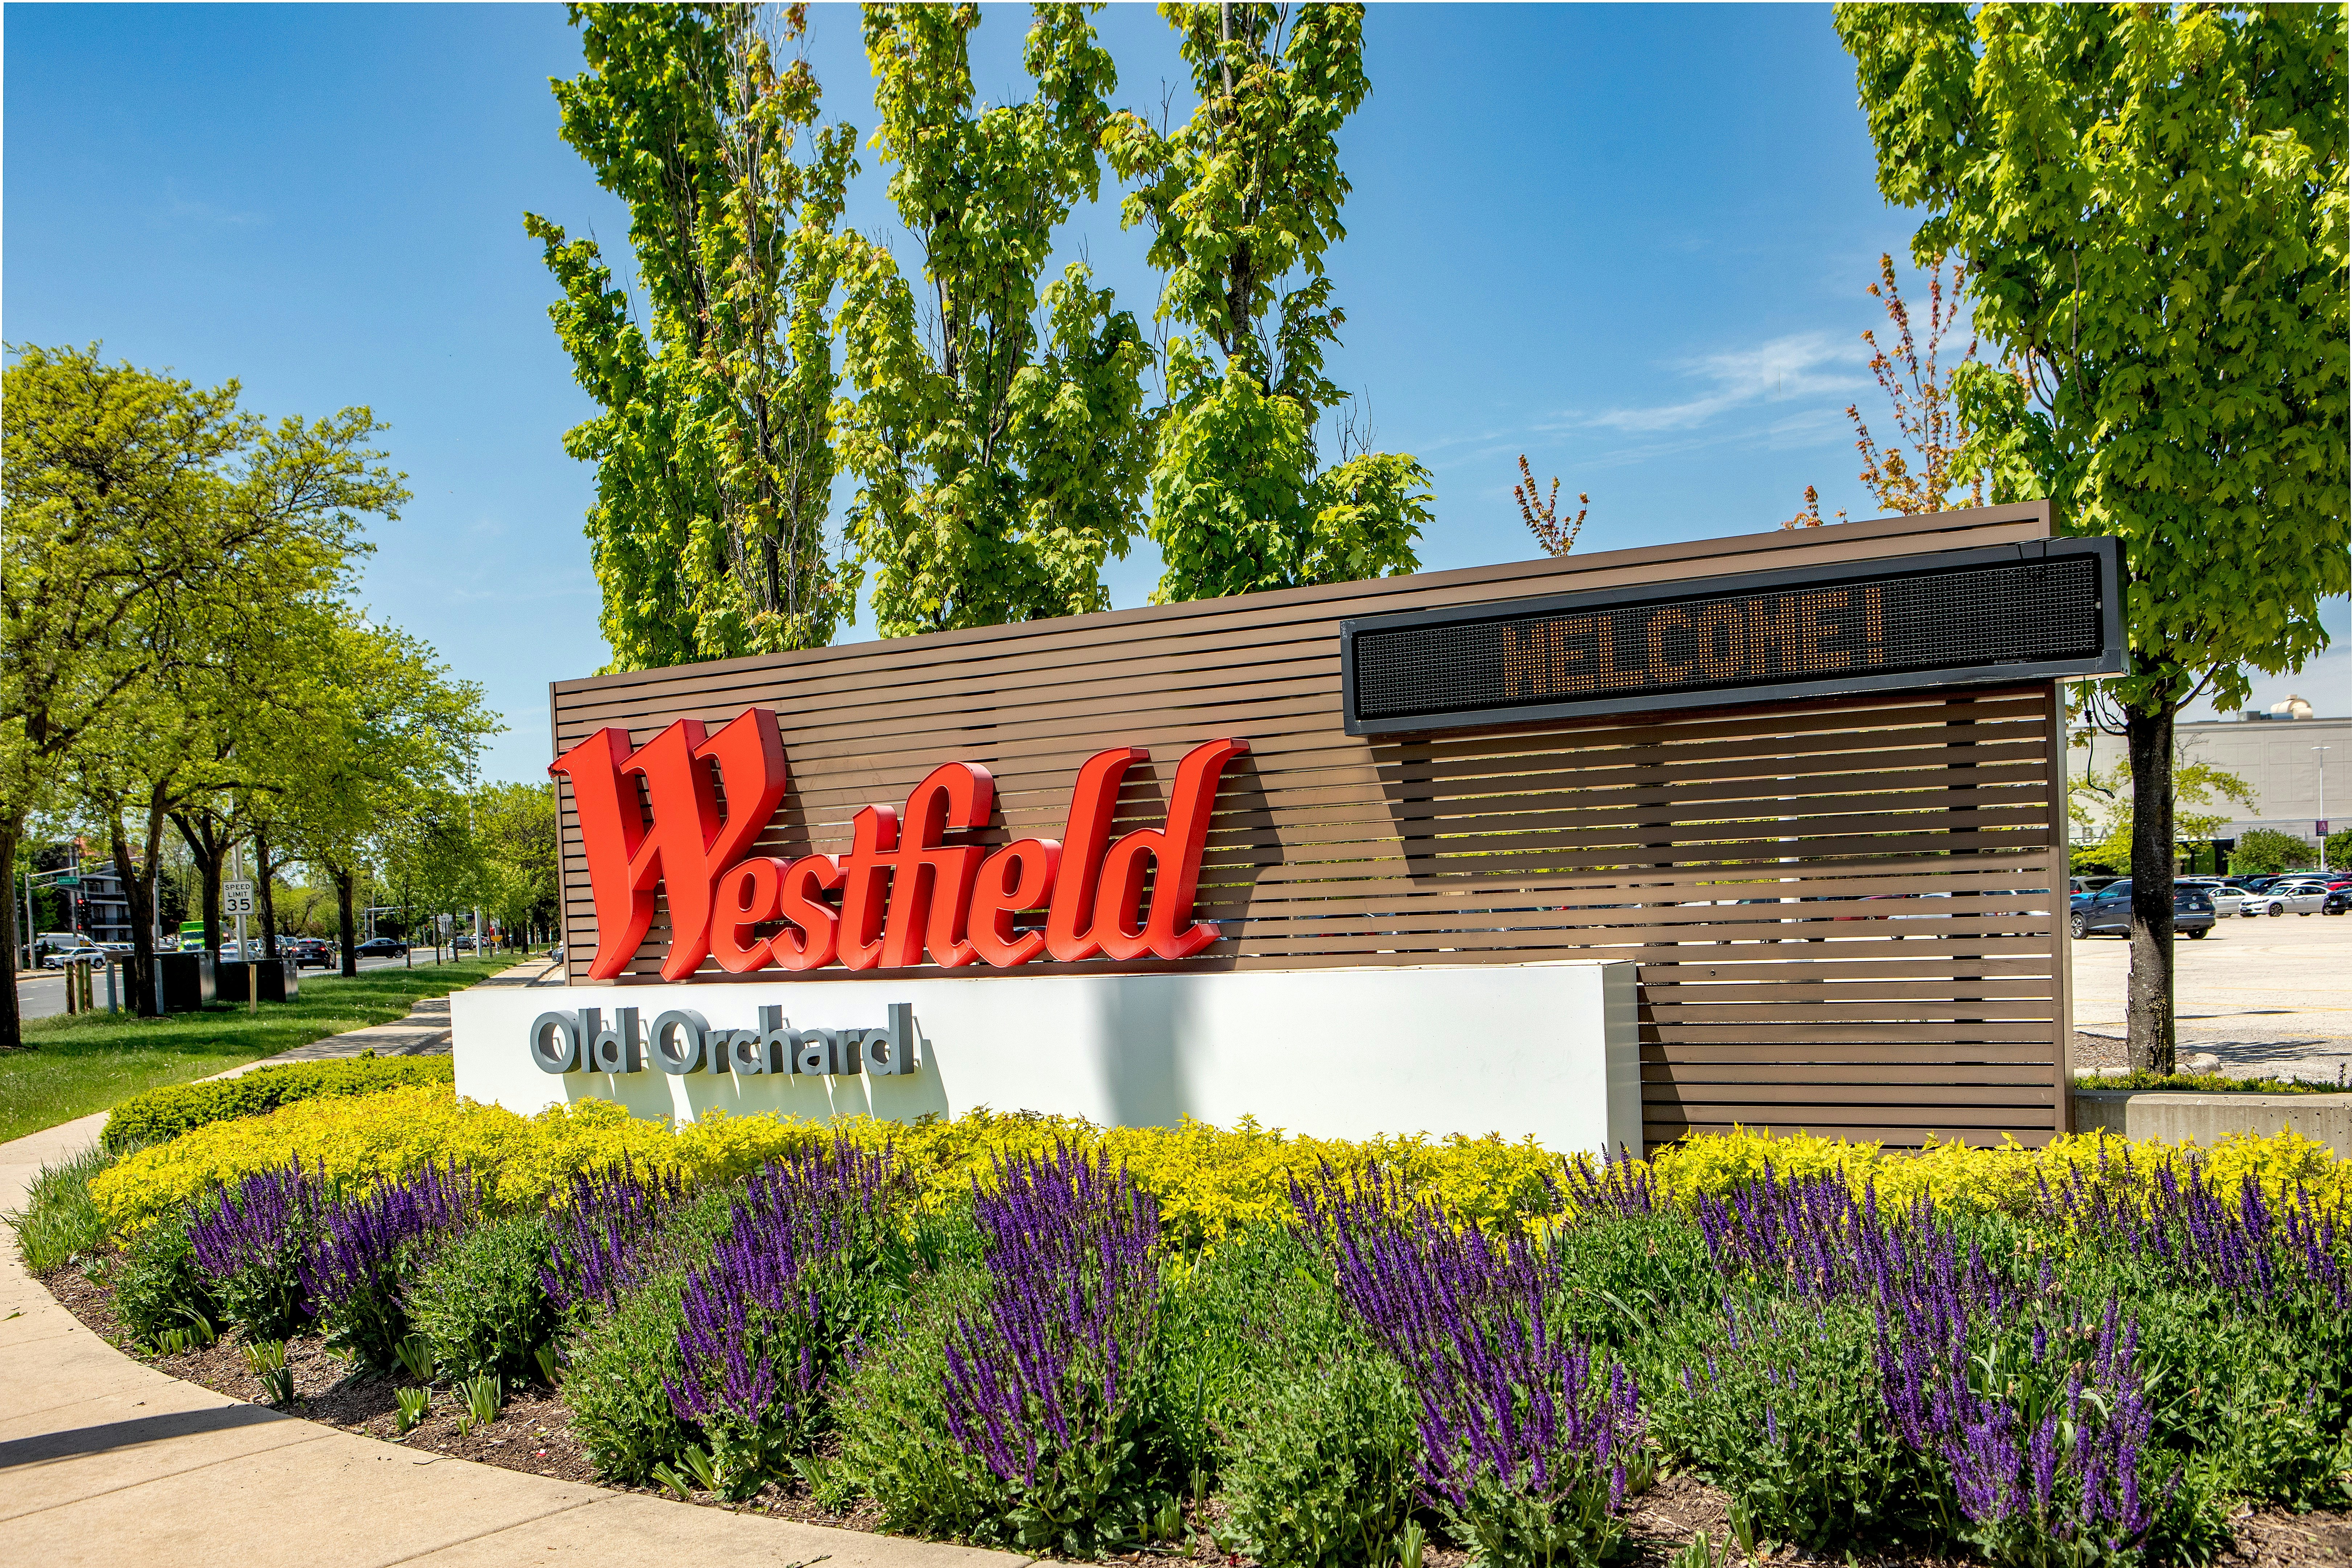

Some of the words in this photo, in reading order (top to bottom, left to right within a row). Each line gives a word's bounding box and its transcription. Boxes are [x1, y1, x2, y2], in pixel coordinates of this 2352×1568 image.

[1502, 587, 1883, 696] WELCOME!
[548, 707, 1250, 981] Westfield
[2319, 822, 2327, 830] A
[227, 898, 250, 911] 35
[530, 1006, 642, 1074] Old
[652, 1003, 914, 1076] Orchard
